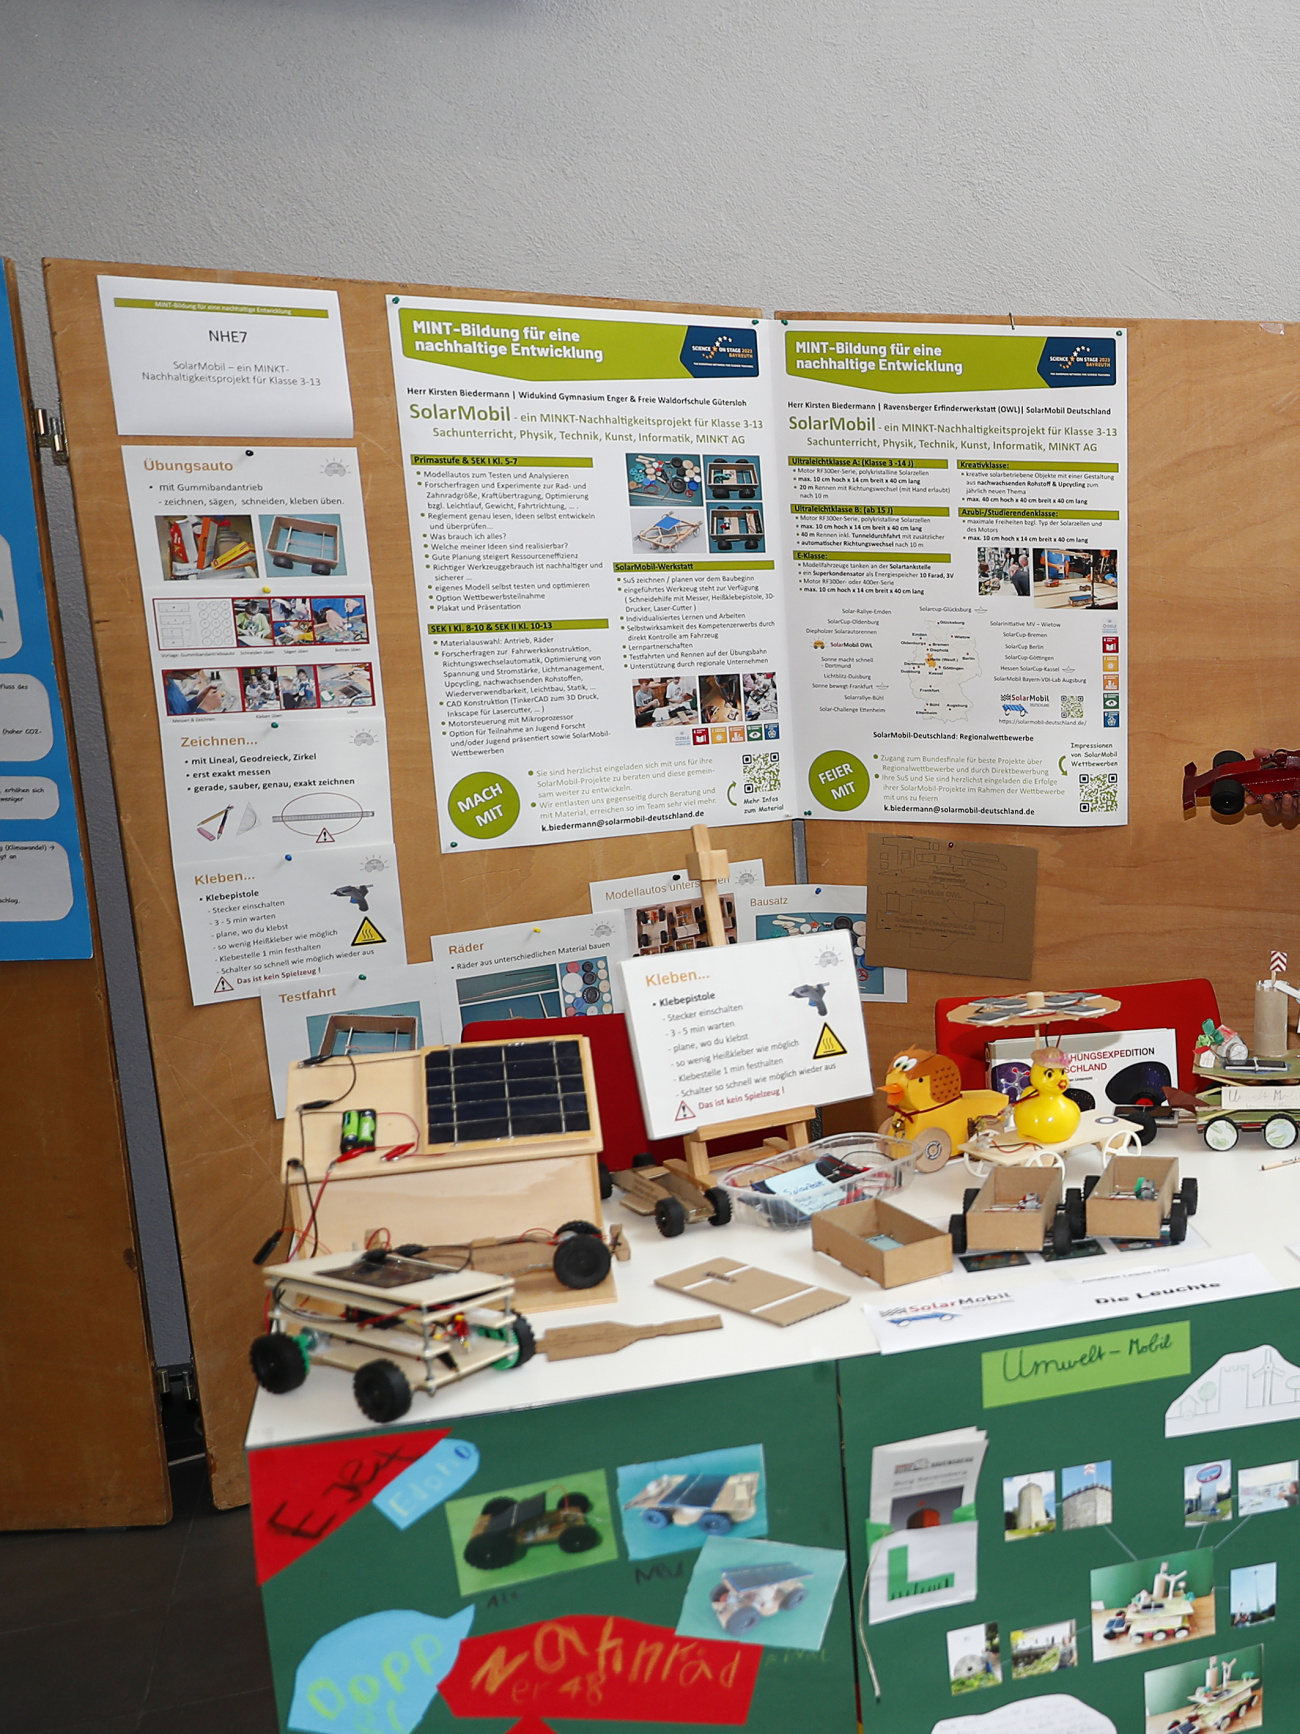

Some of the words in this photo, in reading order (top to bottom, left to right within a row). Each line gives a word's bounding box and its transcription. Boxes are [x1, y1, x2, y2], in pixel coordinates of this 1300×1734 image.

[209, 330, 247, 343] NHE7
[412, 319, 520, 342] MINT-Bildung
[524, 326, 546, 341] für
[549, 328, 581, 343] eine
[415, 340, 508, 358] nachhaltige
[511, 343, 603, 363] Entwicklung
[796, 341, 887, 358] MINT-Bildung
[890, 343, 910, 356] für
[913, 343, 942, 356] eine
[173, 361, 225, 371] SolarMobil
[254, 364, 289, 373] MINKT-
[797, 357, 876, 373] nachhaltige
[879, 359, 963, 375] Entwicklung
[142, 372, 250, 385] Nachhaltigkeitsprojekt
[253, 375, 266, 384] für
[269, 376, 298, 385] Klasse
[300, 377, 321, 386] 3-13
[460, 389, 510, 398] Biedermann
[518, 391, 557, 400] Widukind
[559, 393, 605, 402] Gymnasium
[607, 394, 628, 404] Enger
[658, 396, 710, 405] Waldorfschule
[712, 398, 747, 407] Gütersloh
[410, 403, 510, 421] SolarMobil
[521, 413, 537, 422] ein
[540, 413, 692, 428] MINKT-Nachhaltigkeitsprojekt
[694, 417, 709, 427] für
[711, 418, 741, 428] Klasse
[744, 419, 763, 429] 3-13
[789, 415, 875, 431] SolarMobil
[433, 427, 517, 440] Sachunterricht,
[520, 429, 557, 441] Physik,
[559, 431, 602, 442] Technik,
[605, 432, 636, 443] Kunst,
[639, 432, 693, 444] Informatik,
[696, 434, 729, 444] MINKT
[731, 435, 745, 444] AG
[144, 458, 234, 474] Übungsauto
[959, 461, 1011, 470] Kreativklasse:
[209, 498, 237, 507] sägen,
[241, 497, 288, 506] schneiden,
[961, 509, 1058, 518] Azubi-/Studierendenklasse:
[614, 562, 693, 572] SolarMobil-Werkstatt
[1012, 694, 1049, 703] SolarMobil
[181, 736, 258, 747] Zeichnen...
[873, 731, 958, 740] SolarMobil-Deutschland:
[960, 733, 1034, 742] Regionalwettbewerbe
[240, 754, 291, 763] Geodreieck,
[212, 769, 236, 778] exakt
[818, 762, 854, 786] FEIER
[194, 783, 227, 793] gerade,
[830, 781, 857, 801] MIT
[456, 782, 504, 814] MACH
[475, 804, 505, 829] MIT
[884, 804, 1035, 815] k.biedermann@solarmobil-deutschland.de
[541, 810, 704, 832] k.biedermann@solarmobil-deutschland.de
[195, 873, 255, 885] Kleben...
[206, 890, 259, 902] Klebepistole
[606, 885, 666, 901] Modellautos
[669, 877, 730, 892] untersen
[750, 897, 788, 907] Bausatz
[449, 942, 484, 955] Räder
[457, 961, 479, 970] Räder
[494, 950, 557, 964] unterschiedlichen
[558, 944, 588, 954] Material
[646, 971, 710, 987] Kleben...
[279, 987, 336, 1003] Testfahrt
[659, 992, 715, 1007] Klebepistole
[667, 1011, 697, 1022] Stecker
[699, 1004, 743, 1017] einschalten
[673, 1043, 698, 1053] plane,
[725, 1033, 749, 1043] klebst
[687, 1055, 711, 1065] wenig
[713, 1048, 754, 1060] Heißkleber
[771, 1039, 799, 1050] möglich
[1070, 1047, 1155, 1062] HUNGSEXPEDITION
[1064, 1062, 1107, 1073] SCHLAND
[726, 1095, 743, 1104] kein
[744, 1089, 781, 1102] Spielzeug
[1095, 1295, 1130, 1305] Die
[1136, 1282, 1221, 1300] Leuchte
[907, 1291, 1011, 1313] SolarMobil
[1002, 1345, 1105, 1383] Umwelt
[1128, 1332, 1172, 1355] Mobil
